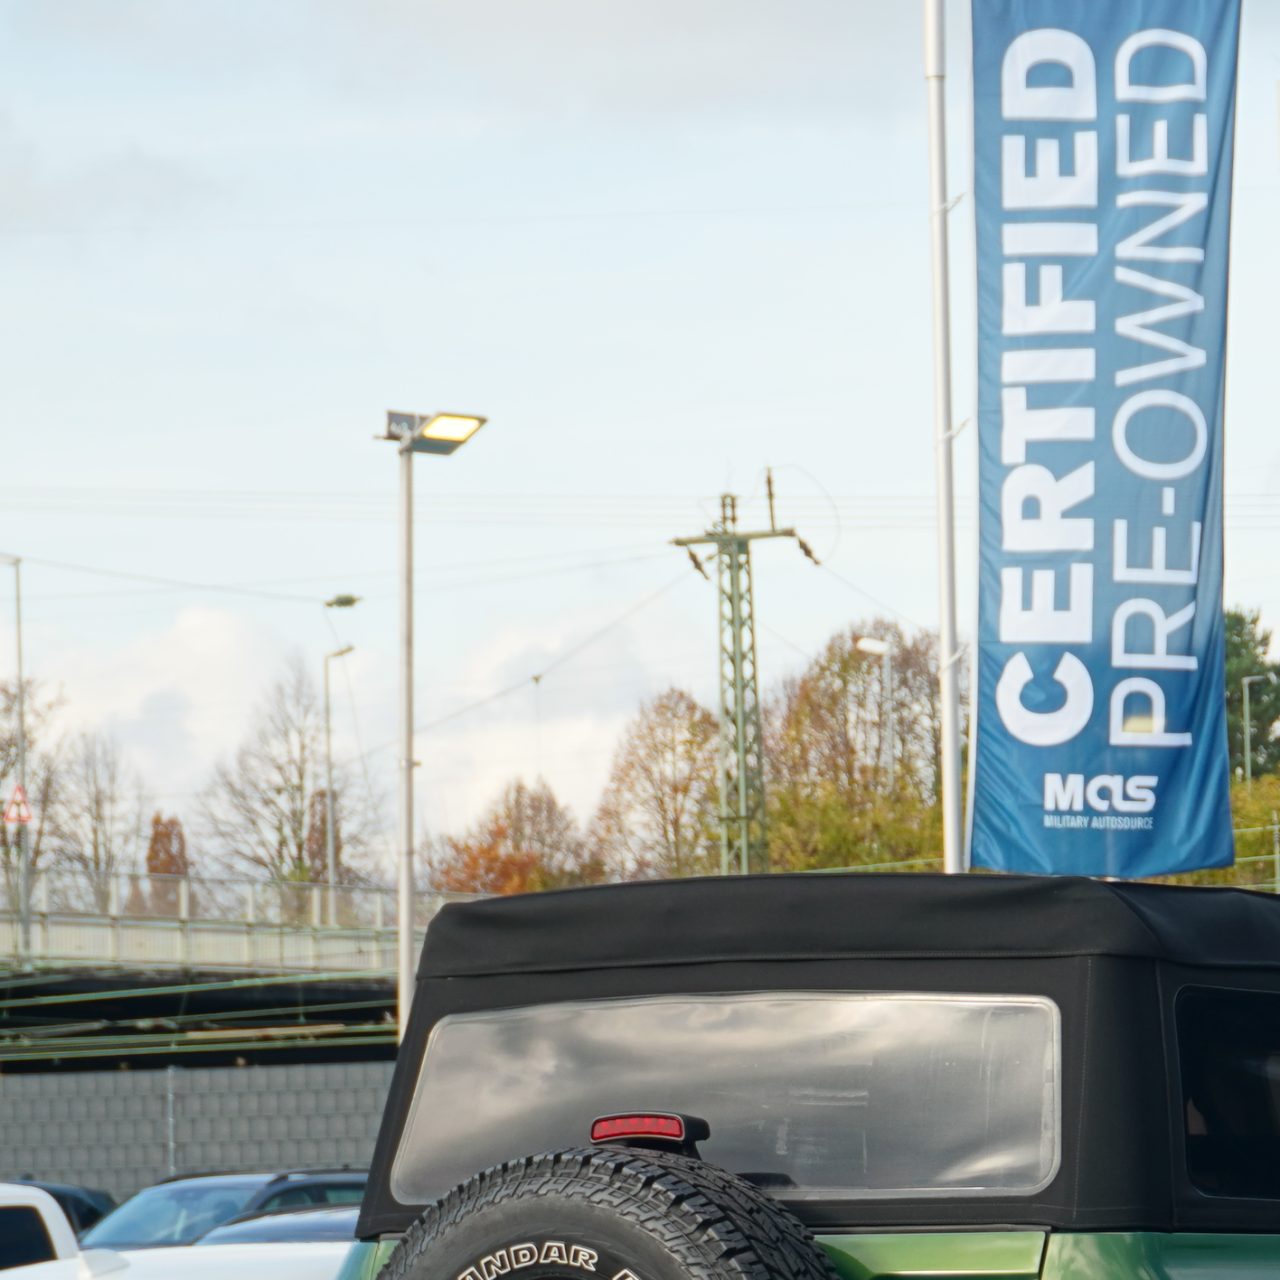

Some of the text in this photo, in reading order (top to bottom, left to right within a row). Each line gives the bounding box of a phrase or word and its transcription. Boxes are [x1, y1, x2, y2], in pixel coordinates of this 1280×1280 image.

[995, 27, 1098, 747] CERTIFIED
[1110, 27, 1208, 748] PRE-OWNED
[1043, 815, 1153, 830] MILITARY AUTOSOURCE
